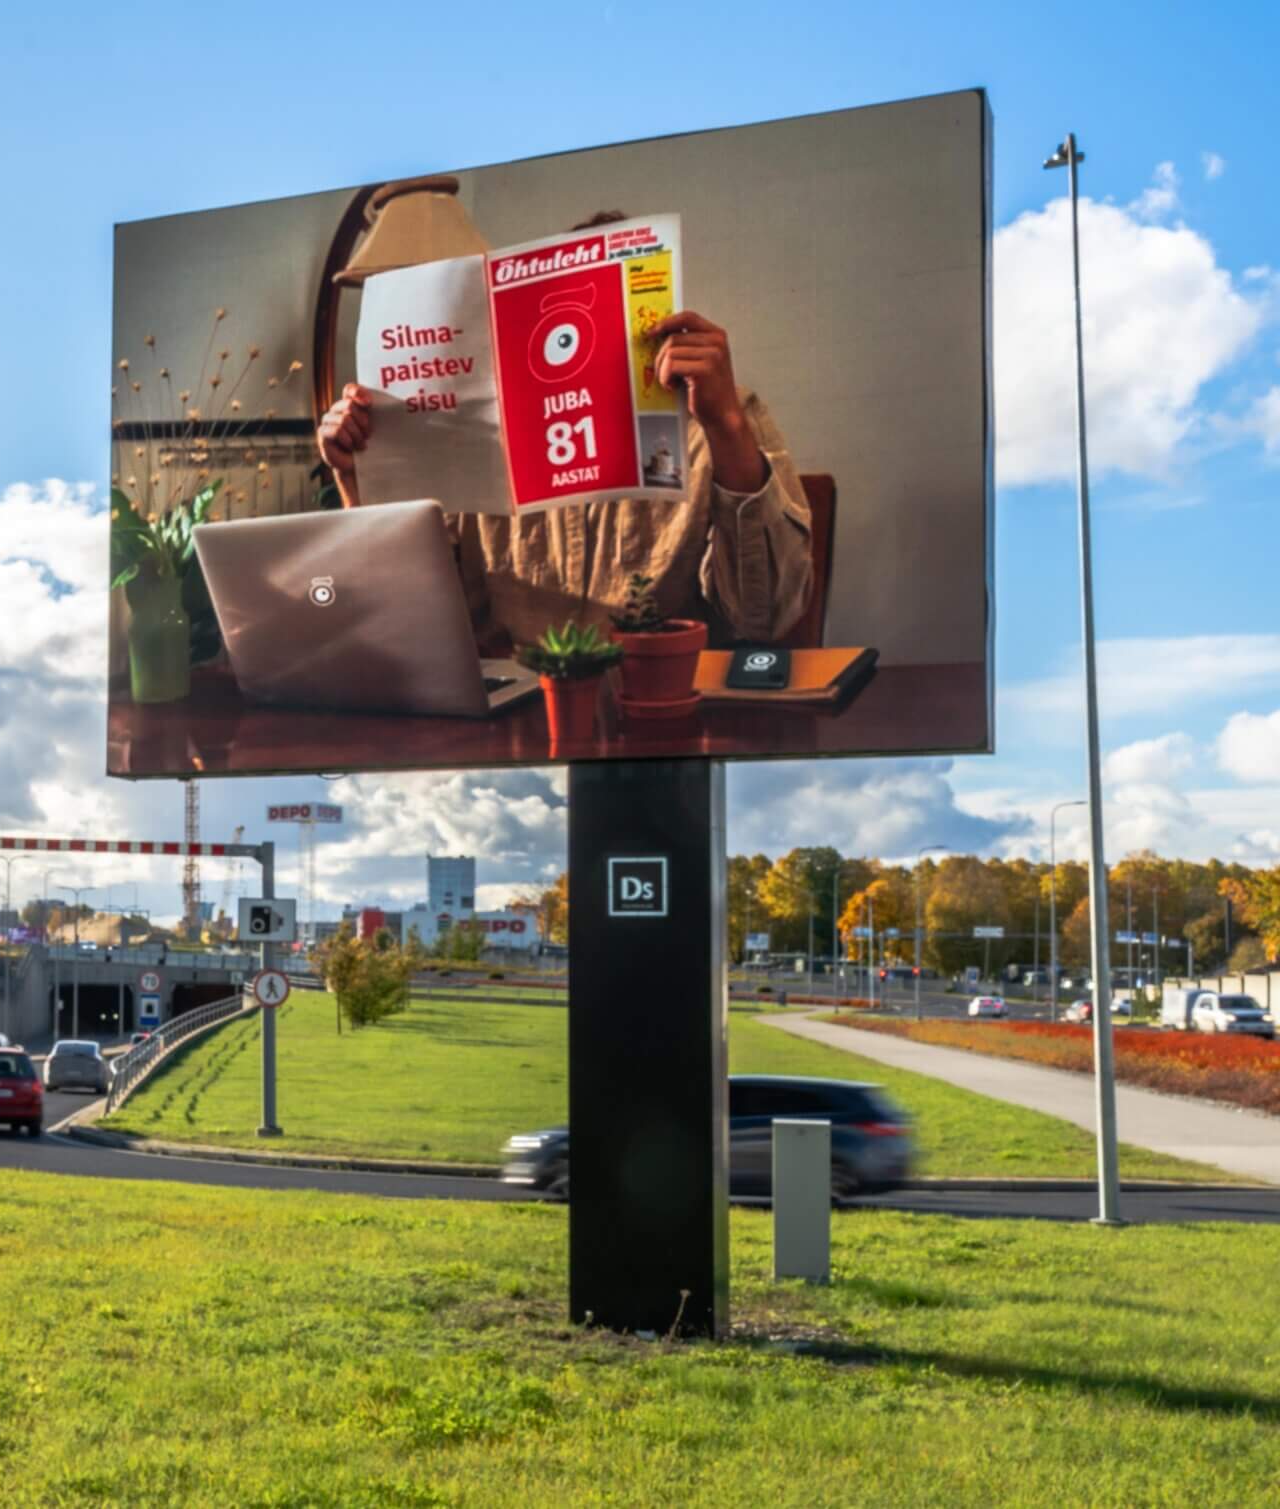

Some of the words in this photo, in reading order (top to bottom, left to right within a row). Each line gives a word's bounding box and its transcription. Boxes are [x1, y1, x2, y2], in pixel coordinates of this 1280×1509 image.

[495, 243, 601, 284] Õhtuleht
[381, 324, 464, 350] Silma-
[380, 356, 475, 389] paistev
[405, 388, 457, 413] sisu
[543, 387, 593, 420] JUBA
[546, 415, 598, 466] 81
[551, 465, 600, 488] AASTAT
[268, 805, 310, 820] DEPO
[621, 876, 655, 901] Ds
